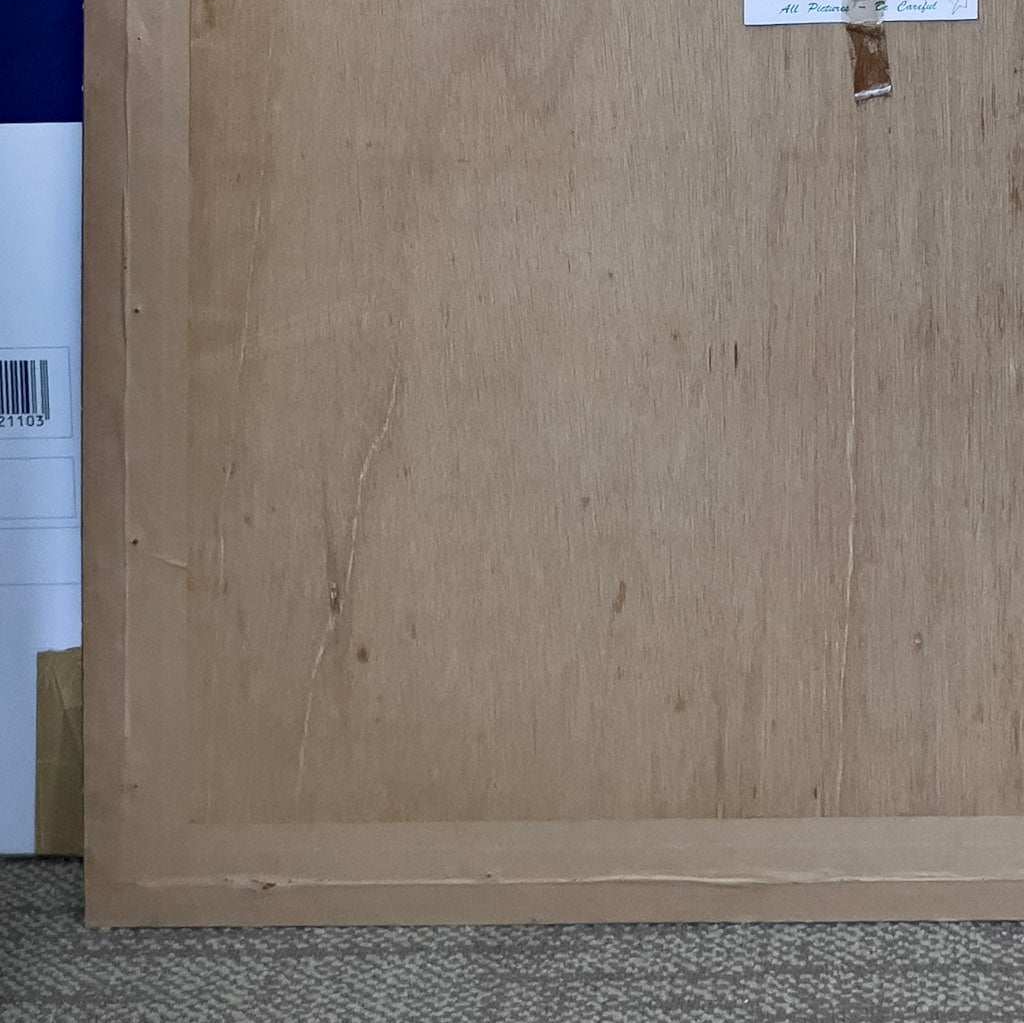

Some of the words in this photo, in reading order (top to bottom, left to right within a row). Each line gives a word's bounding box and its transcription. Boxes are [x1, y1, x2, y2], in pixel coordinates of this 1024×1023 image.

[779, 2, 800, 15] All
[808, 1, 849, 13] Pictures
[897, 0, 938, 13] Careful
